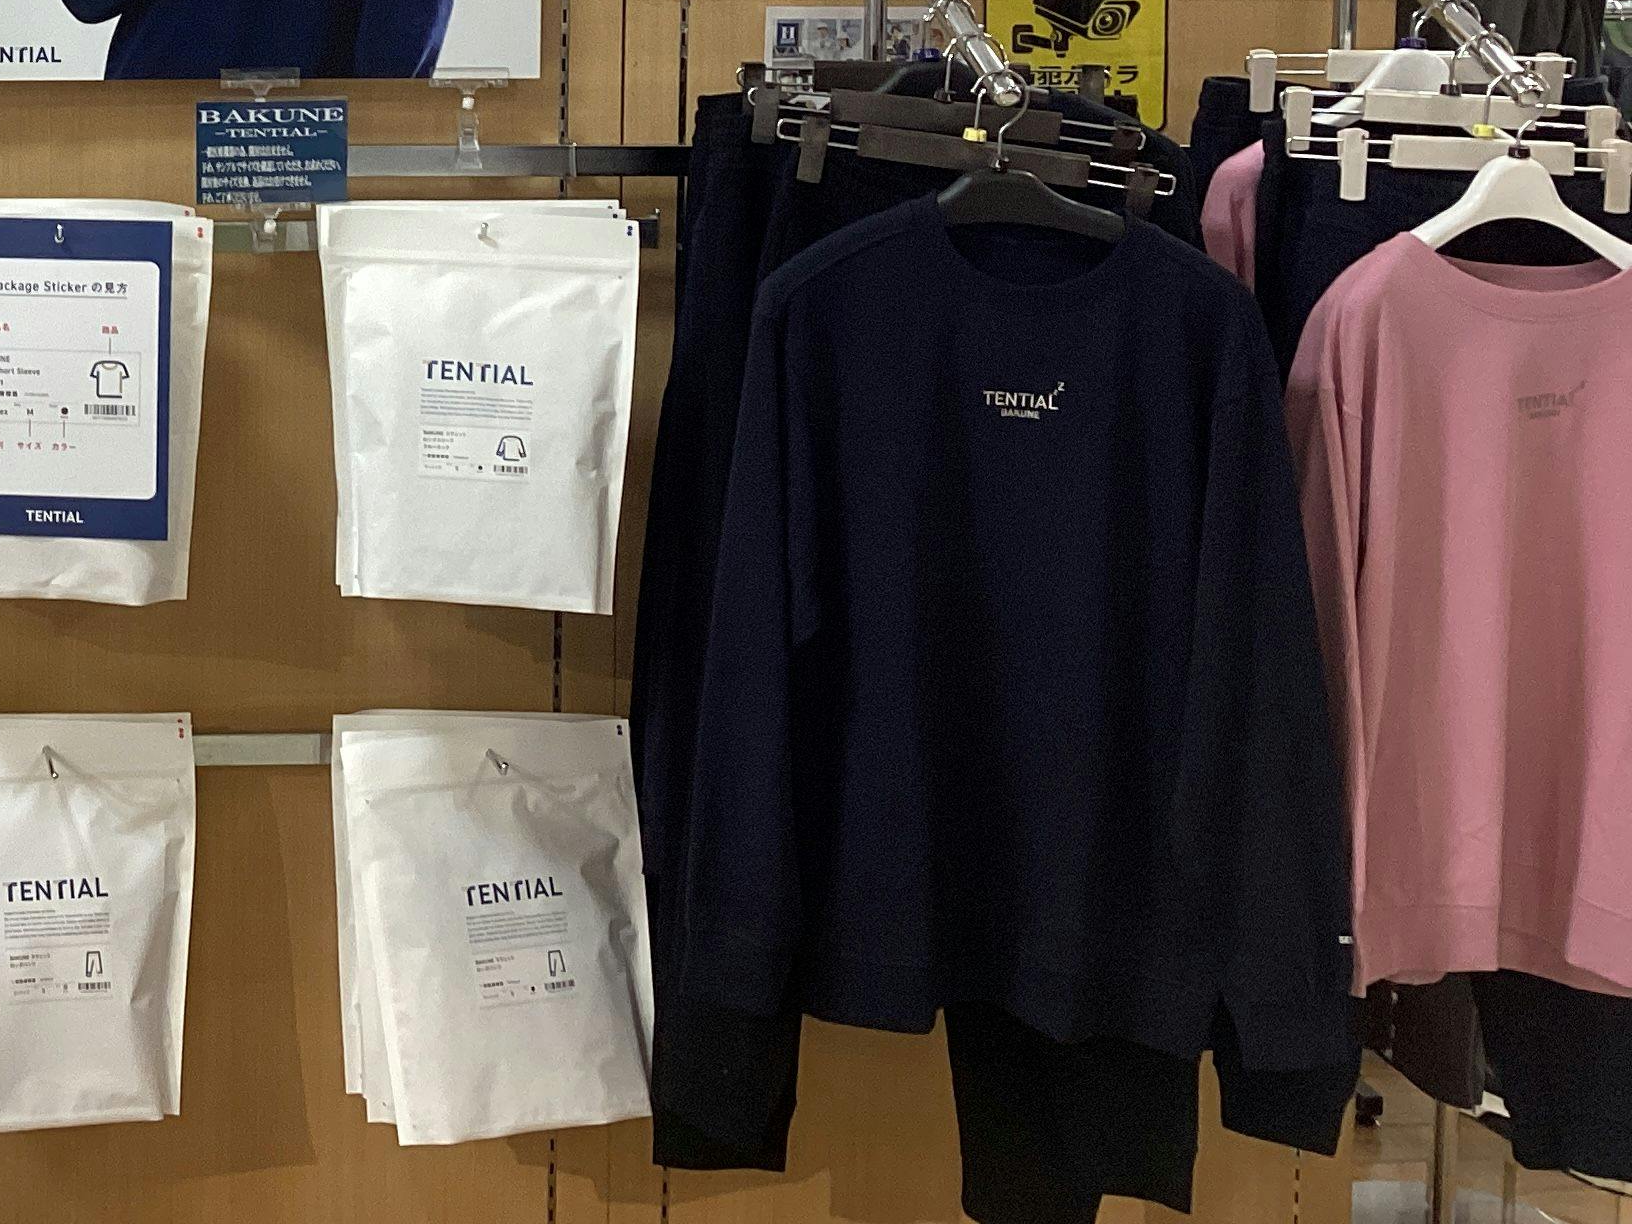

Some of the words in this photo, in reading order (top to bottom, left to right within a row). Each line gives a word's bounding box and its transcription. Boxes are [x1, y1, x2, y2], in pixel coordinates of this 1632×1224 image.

[198, 106, 344, 124] BAKUNE
[43, 280, 87, 293] Sticker
[91, 281, 128, 295] の見方
[422, 359, 534, 386] TENTIAL
[982, 389, 1059, 411] TENTIAL
[25, 509, 84, 524] TENTIAL
[3, 876, 109, 903] TENTIAL
[463, 876, 564, 907] TENTIAL
